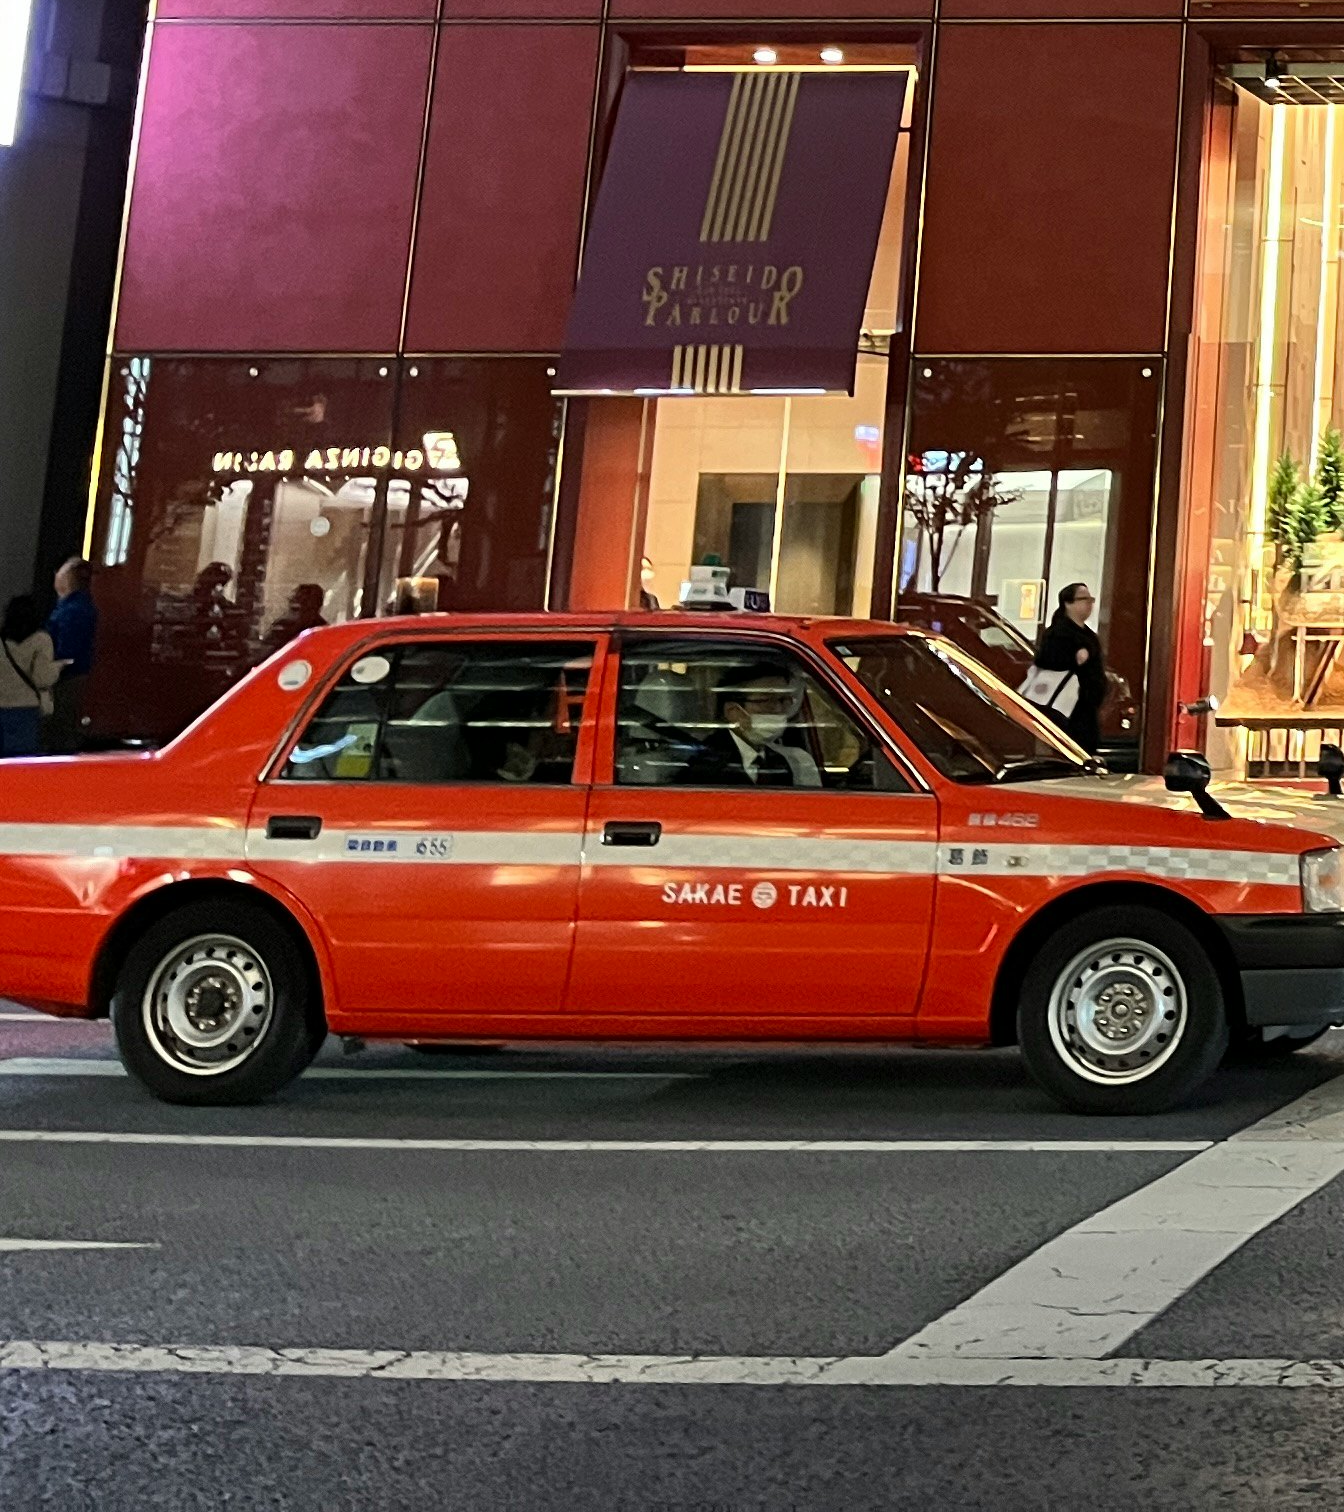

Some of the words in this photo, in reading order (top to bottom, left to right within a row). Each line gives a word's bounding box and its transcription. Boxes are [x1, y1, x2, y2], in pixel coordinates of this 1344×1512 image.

[642, 265, 803, 301] SHISEIDO
[645, 289, 791, 326] PARLOUR
[661, 882, 743, 905] SAKAE
[788, 885, 848, 907] TAXI
